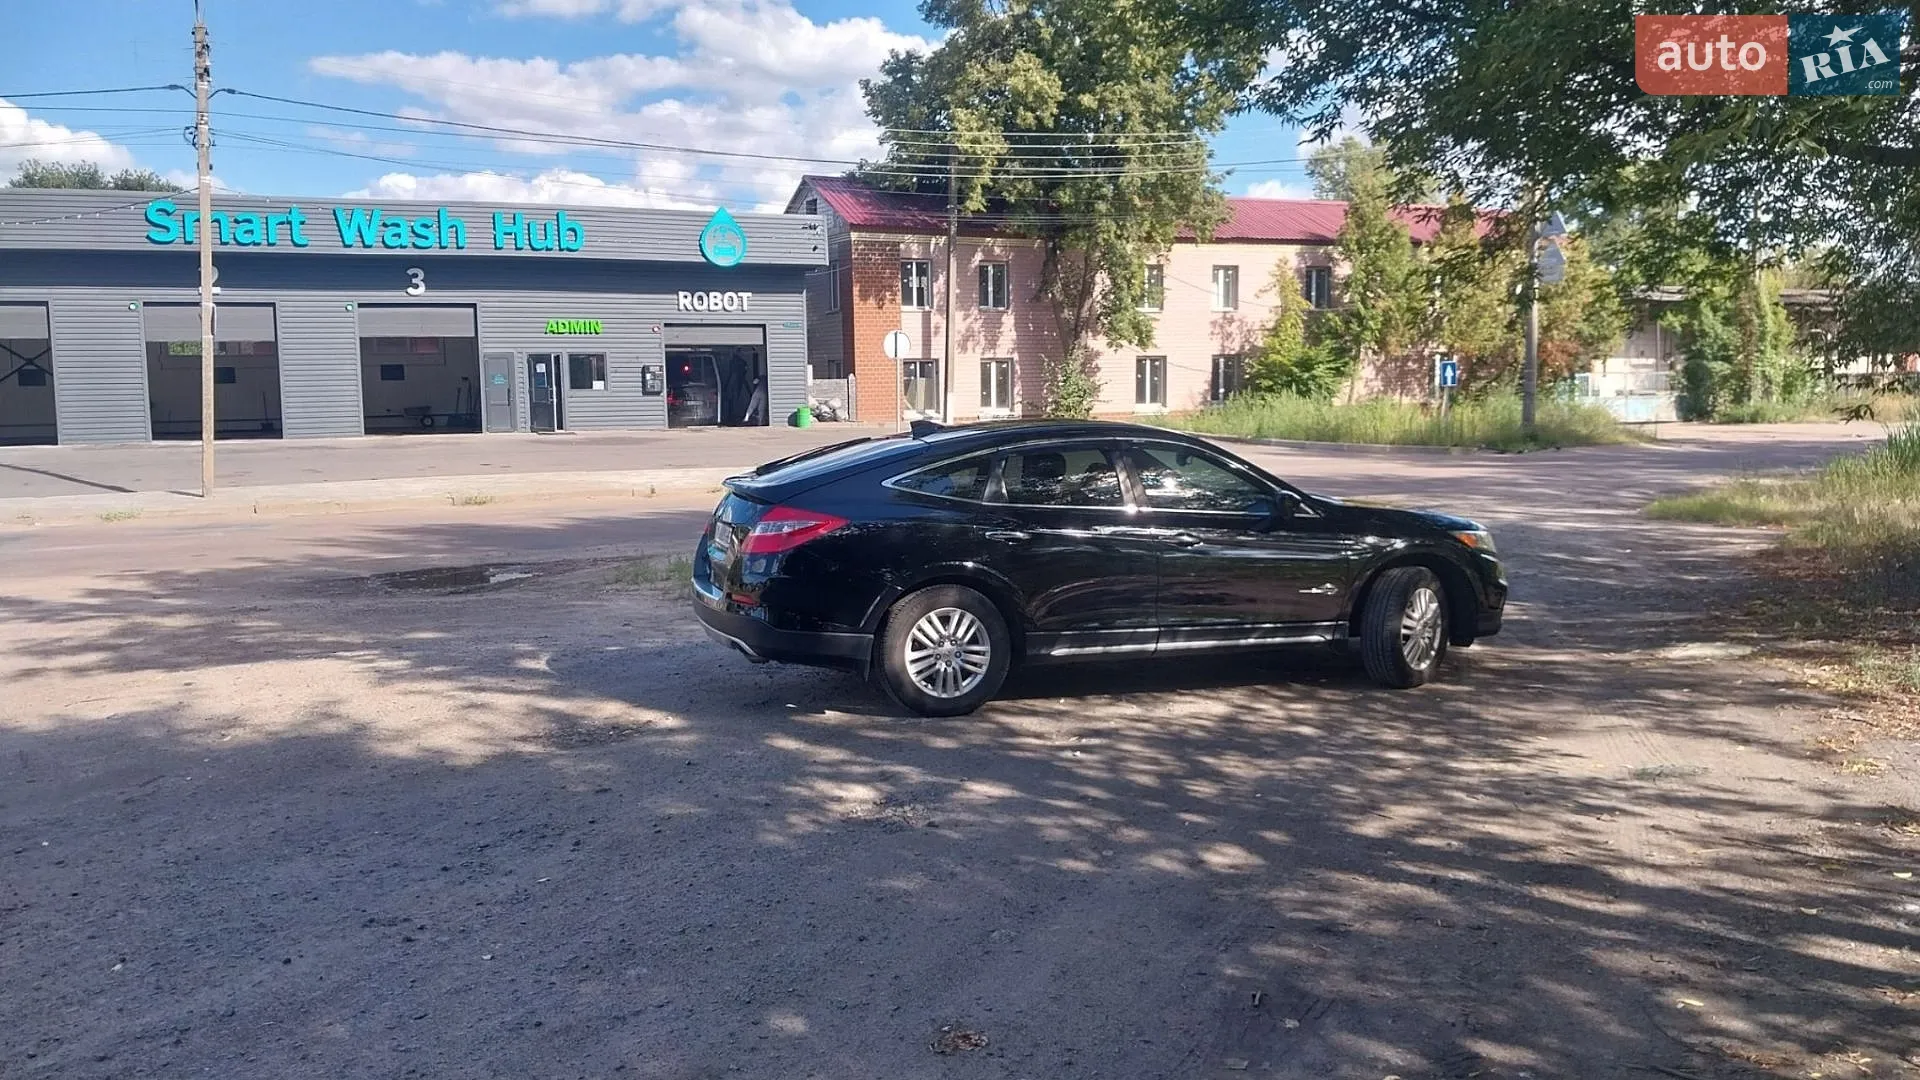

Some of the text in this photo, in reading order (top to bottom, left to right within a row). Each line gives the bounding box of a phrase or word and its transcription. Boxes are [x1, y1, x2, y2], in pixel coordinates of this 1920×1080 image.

[144, 200, 585, 251] Smart Wash Hub
[405, 267, 426, 296] 3
[677, 291, 752, 311] ROBOT
[544, 319, 604, 335] ADMIN
